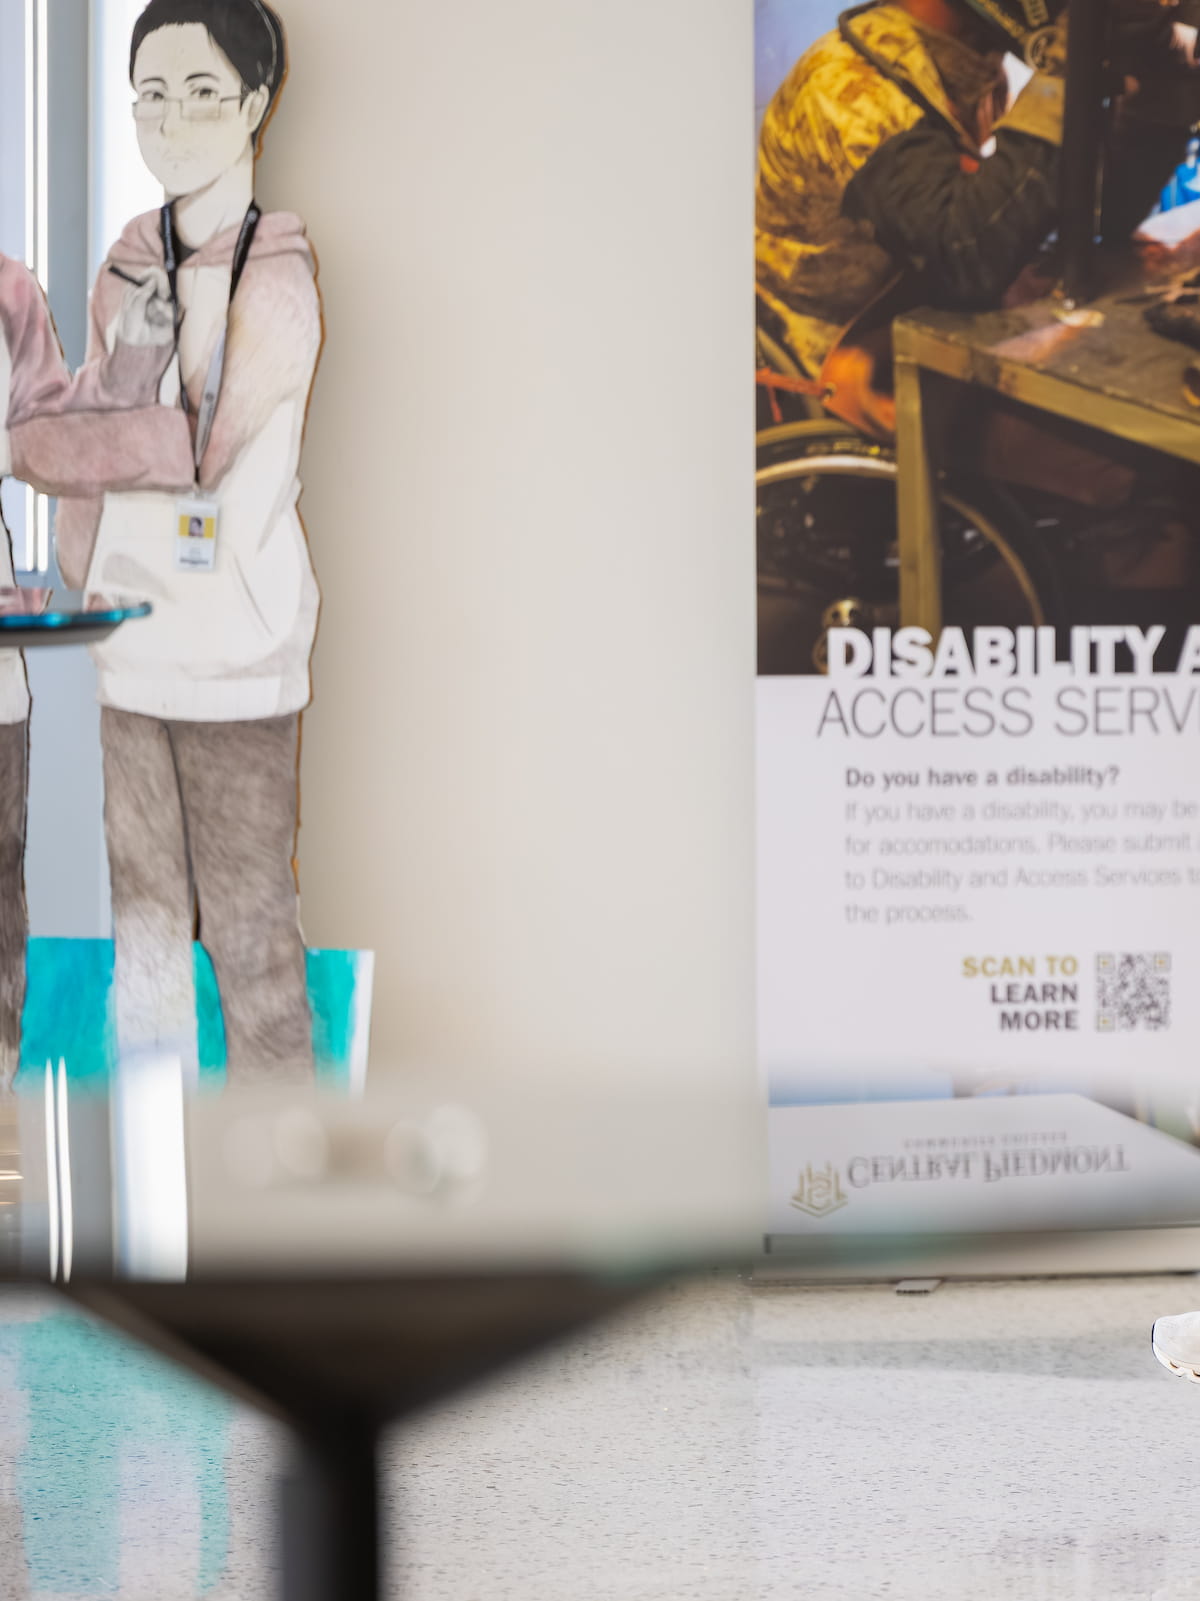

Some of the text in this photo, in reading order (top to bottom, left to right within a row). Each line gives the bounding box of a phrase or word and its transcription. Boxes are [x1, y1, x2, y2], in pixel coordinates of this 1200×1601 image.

[826, 625, 1167, 678] DISABILITY
[816, 686, 1035, 738] ACCESS
[845, 764, 1121, 792] Do you have a disability?
[844, 801, 858, 822] If
[863, 804, 901, 827] you
[906, 802, 957, 823] have
[962, 804, 977, 822] a
[981, 800, 1075, 825] disability,
[1080, 803, 1118, 824] you
[1123, 802, 1168, 823] may
[1173, 799, 1199, 820] be
[844, 835, 872, 857] for
[1047, 831, 1117, 854] Please
[1122, 831, 1192, 853] submit
[844, 870, 866, 891] to
[871, 866, 964, 894] Disability
[968, 868, 1009, 890] and
[1014, 866, 1089, 888] Access
[1094, 865, 1183, 889] Services
[844, 903, 973, 927] the process.
[962, 955, 1079, 978] SCAN TO
[990, 982, 1078, 1005] LEARN
[999, 1009, 1079, 1032] MORE
